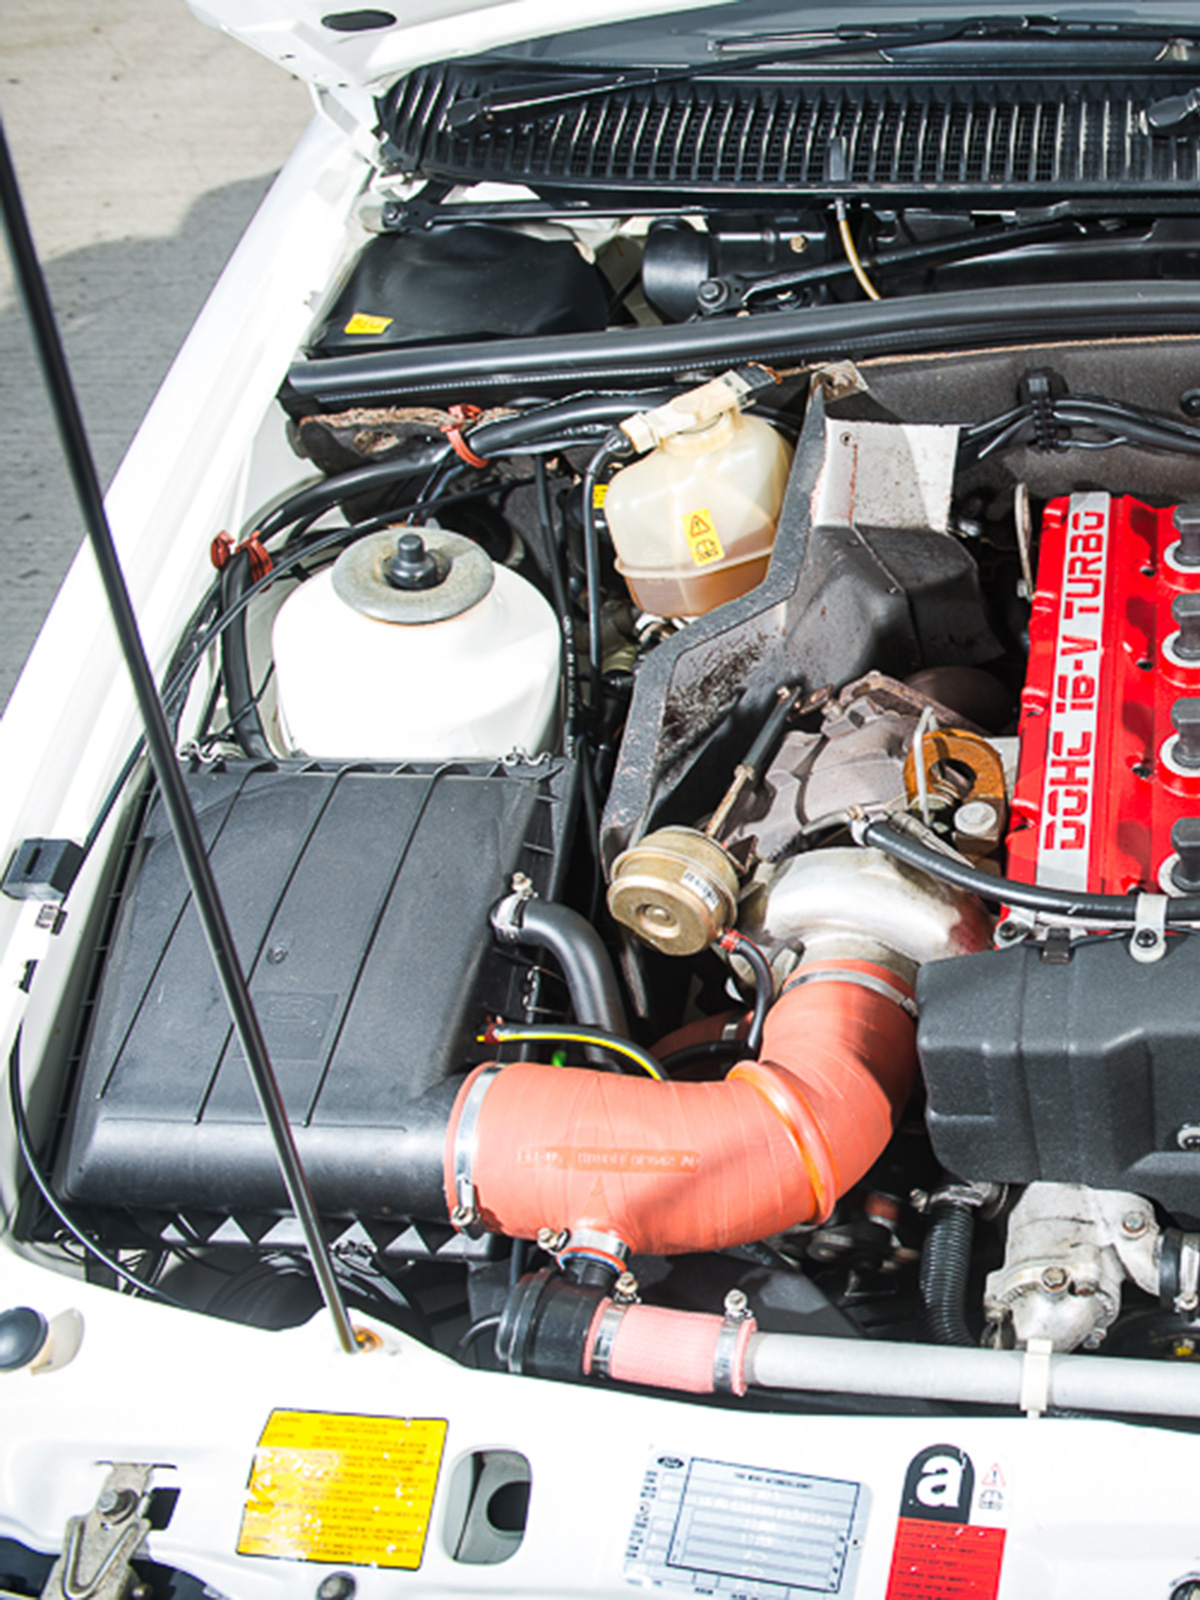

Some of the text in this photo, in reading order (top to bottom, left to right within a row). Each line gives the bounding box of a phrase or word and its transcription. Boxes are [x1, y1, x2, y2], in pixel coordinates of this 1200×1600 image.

[1044, 511, 1105, 850] DOHC 16-V TURBO
[916, 1454, 963, 1508] a
